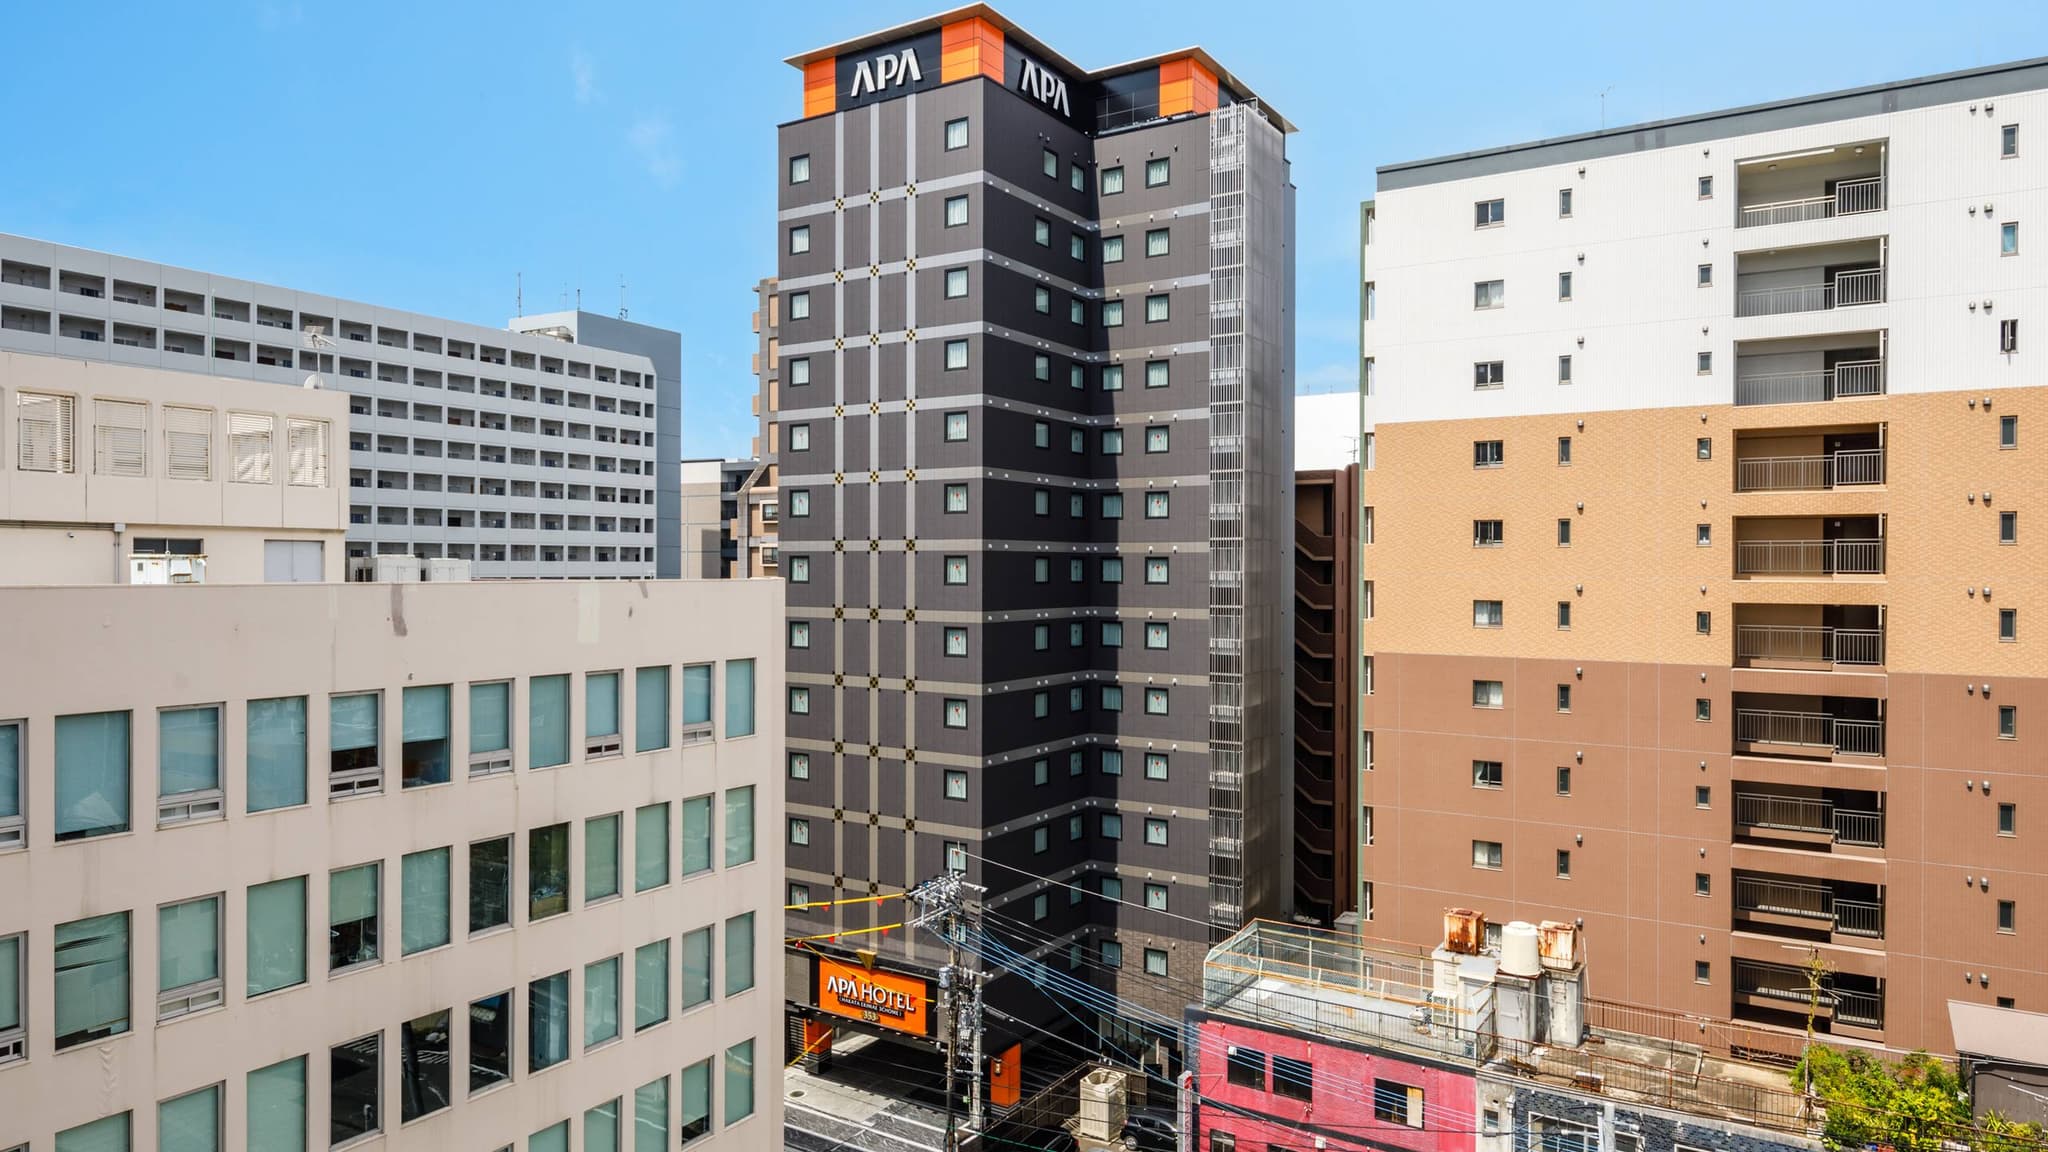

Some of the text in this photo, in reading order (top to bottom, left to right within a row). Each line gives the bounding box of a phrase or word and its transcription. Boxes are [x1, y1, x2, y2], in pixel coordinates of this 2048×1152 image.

[850, 48, 922, 97] APA
[1021, 58, 1071, 118] APA
[827, 975, 915, 1011] APA HOTEL
